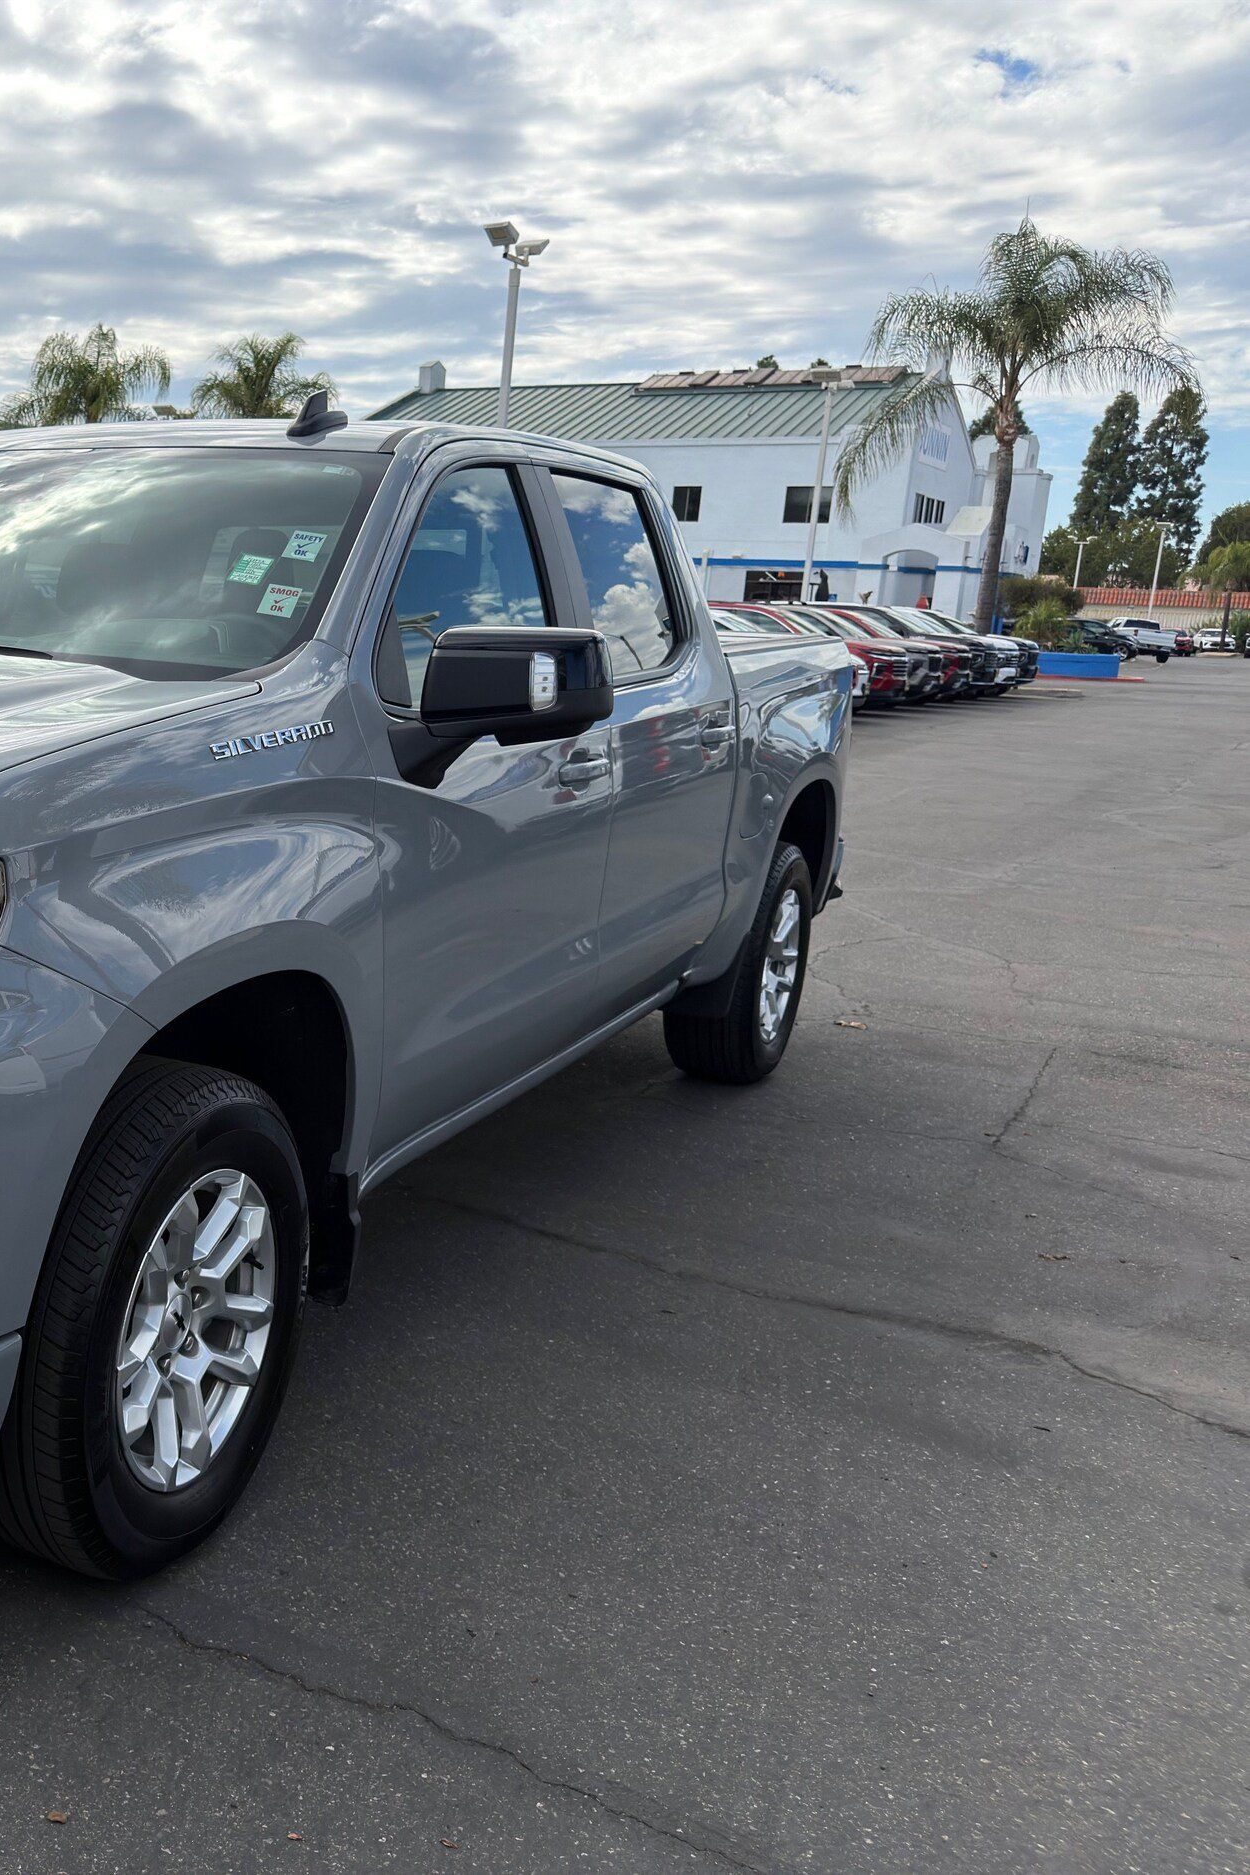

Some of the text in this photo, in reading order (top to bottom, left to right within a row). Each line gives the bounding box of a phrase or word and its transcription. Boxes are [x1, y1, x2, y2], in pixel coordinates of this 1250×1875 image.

[293, 533, 324, 543] SAFETY
[294, 549, 308, 557] OK
[270, 587, 299, 597] SMOG
[270, 604, 284, 612] OK
[209, 719, 335, 760] SILVERADO
